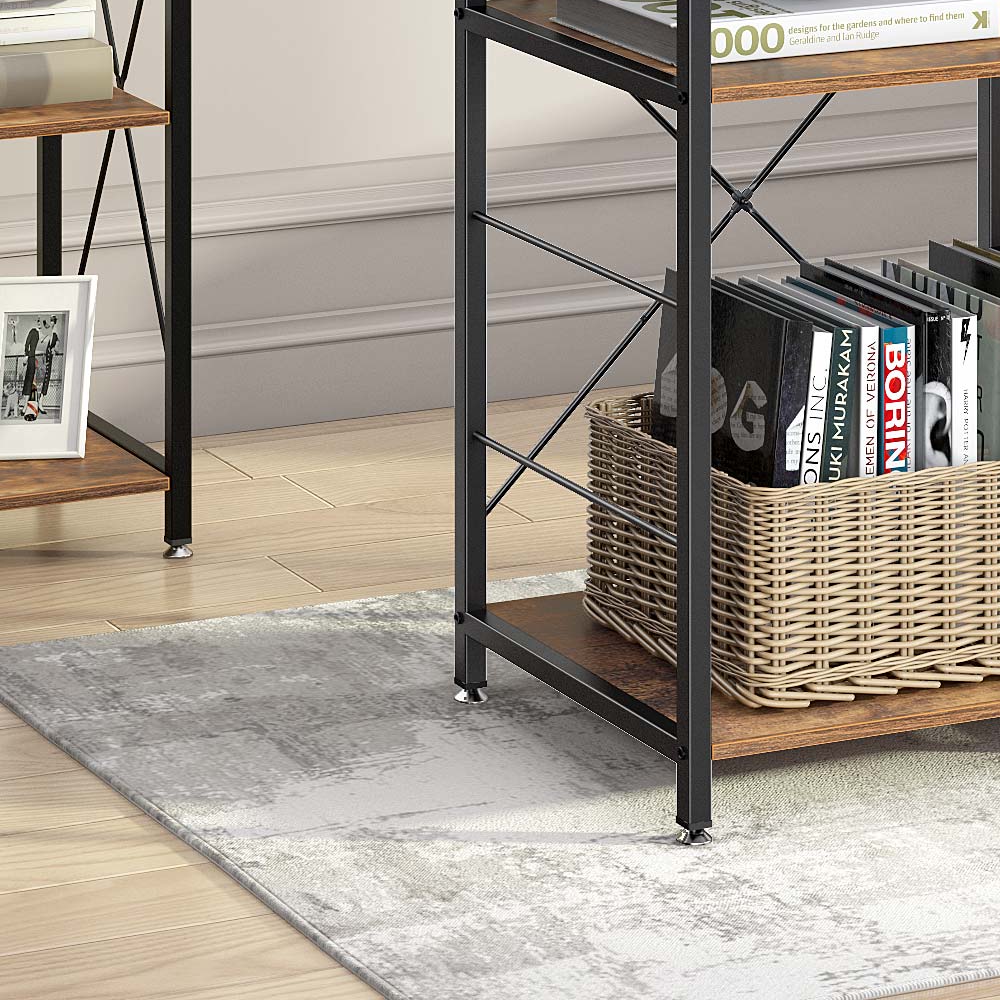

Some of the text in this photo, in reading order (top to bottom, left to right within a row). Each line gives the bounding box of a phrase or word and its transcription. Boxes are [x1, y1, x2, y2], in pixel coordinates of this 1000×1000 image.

[711, 22, 785, 59] 000
[788, 11, 965, 35] designs for the gardens and where to find them
[789, 30, 880, 46] Geraldine and Ian Rudge
[866, 341, 876, 402] VERONA
[803, 368, 828, 485] ONS INC.
[828, 329, 854, 481] UKI MURAKAM
[866, 411, 876, 429] OF
[885, 342, 906, 473] BORIN
